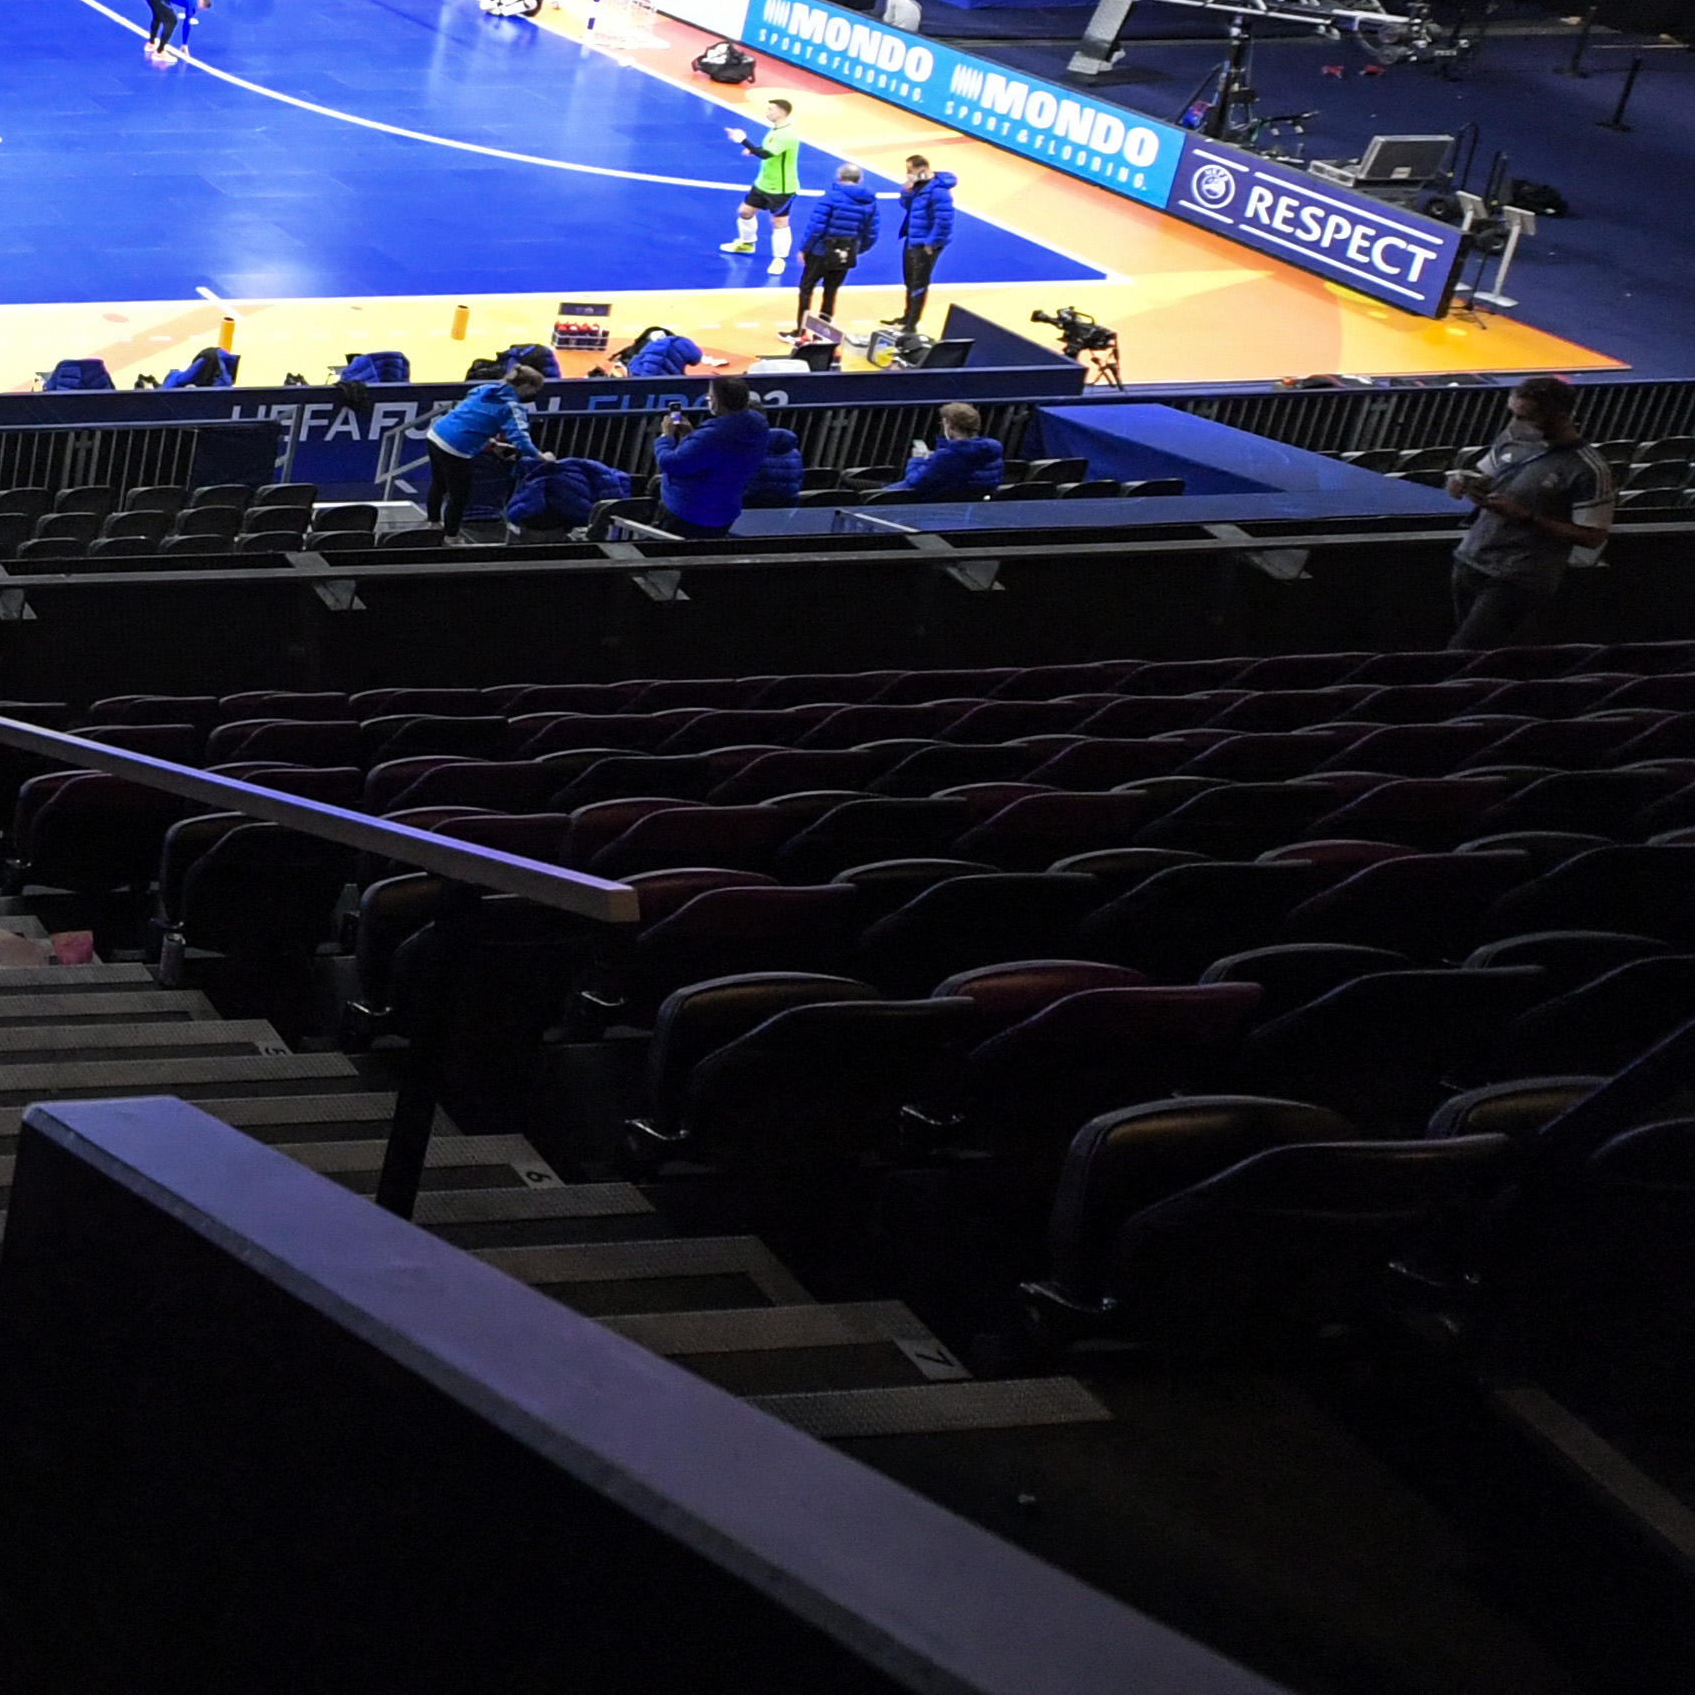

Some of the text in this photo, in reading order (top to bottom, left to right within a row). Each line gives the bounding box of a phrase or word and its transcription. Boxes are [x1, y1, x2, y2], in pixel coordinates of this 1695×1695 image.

[788, 2, 934, 83] MONDO
[981, 72, 1160, 167] MONDO
[1245, 184, 1437, 285] RESPECT
